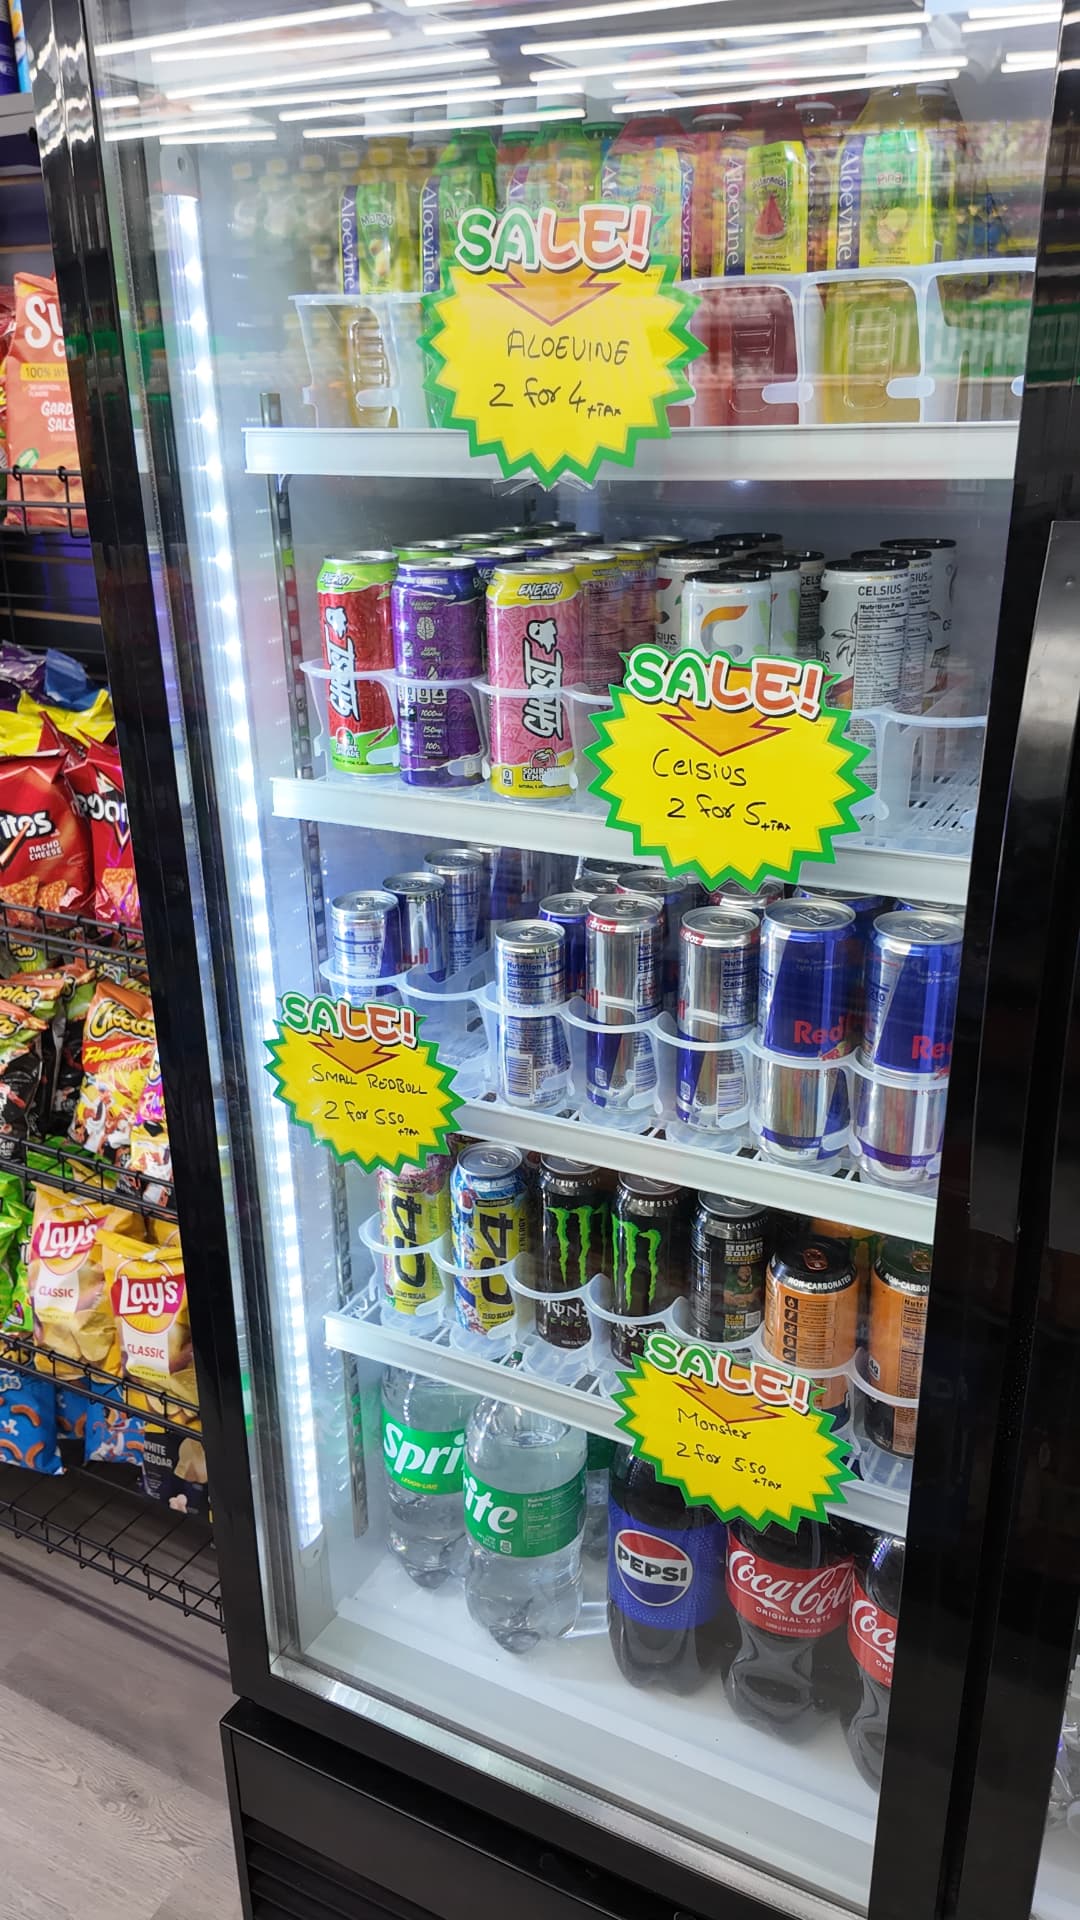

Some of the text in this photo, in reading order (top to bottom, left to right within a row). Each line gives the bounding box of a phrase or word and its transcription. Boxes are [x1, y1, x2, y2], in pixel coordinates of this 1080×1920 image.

[680, 158, 694, 268] Aloevine
[724, 157, 744, 266] Aloevine
[837, 151, 860, 262] Aloevine
[341, 196, 356, 290] Aloevine
[422, 185, 438, 285] Aloevine
[455, 203, 652, 273] SALE!
[489, 383, 514, 408] 2
[524, 377, 561, 408] for
[568, 380, 587, 414] 4
[518, 582, 563, 597] ENERGY
[857, 584, 902, 597] CELSIUS
[325, 622, 360, 723] GHST
[522, 637, 563, 741] GHST
[625, 651, 826, 723] SALE!
[652, 748, 747, 787] Celsius
[666, 797, 687, 819] 2
[697, 794, 735, 819] for
[29, 840, 60, 855] NACHO
[29, 847, 63, 861] CHEESE
[282, 993, 417, 1049] SALE!
[793, 1016, 843, 1045] Red
[311, 1063, 428, 1096] SMALL REDBULL
[323, 1100, 340, 1120] 2
[344, 1100, 369, 1123] for
[38, 1218, 98, 1260] Lay's
[39, 1286, 75, 1299] CLASSIC
[118, 1275, 179, 1317] Lay's
[787, 1274, 852, 1290] NON-CARBONATED
[127, 1343, 165, 1360] CLASSIC
[644, 1331, 811, 1416] SALE!
[677, 1407, 752, 1440] Monster
[676, 1442, 690, 1458] 2
[693, 1443, 722, 1465] for
[616, 1545, 688, 1583] PEPSI
[755, 1596, 801, 1624] ORIGINAL
